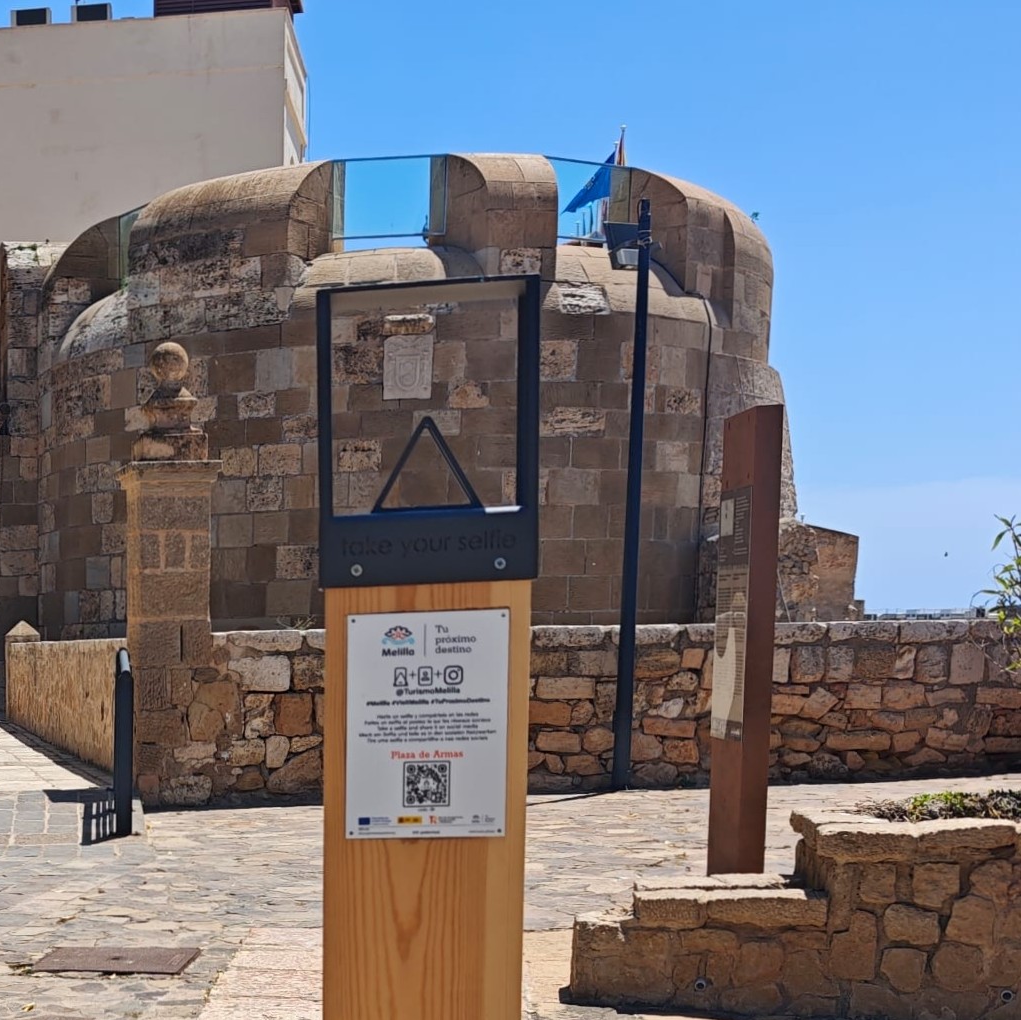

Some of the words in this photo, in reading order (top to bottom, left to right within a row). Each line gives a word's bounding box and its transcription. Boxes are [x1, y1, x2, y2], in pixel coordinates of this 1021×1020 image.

[341, 536, 393, 557] take
[401, 534, 451, 558] your
[458, 528, 517, 551] selfie
[435, 625, 449, 634] Tu
[435, 634, 476, 645] próximo
[382, 648, 415, 657] Melilla
[435, 645, 472, 654] destino
[396, 687, 460, 697] @TurismoMelilla
[391, 751, 416, 759] Plaza
[419, 750, 430, 758] de
[433, 750, 464, 758] Armas
